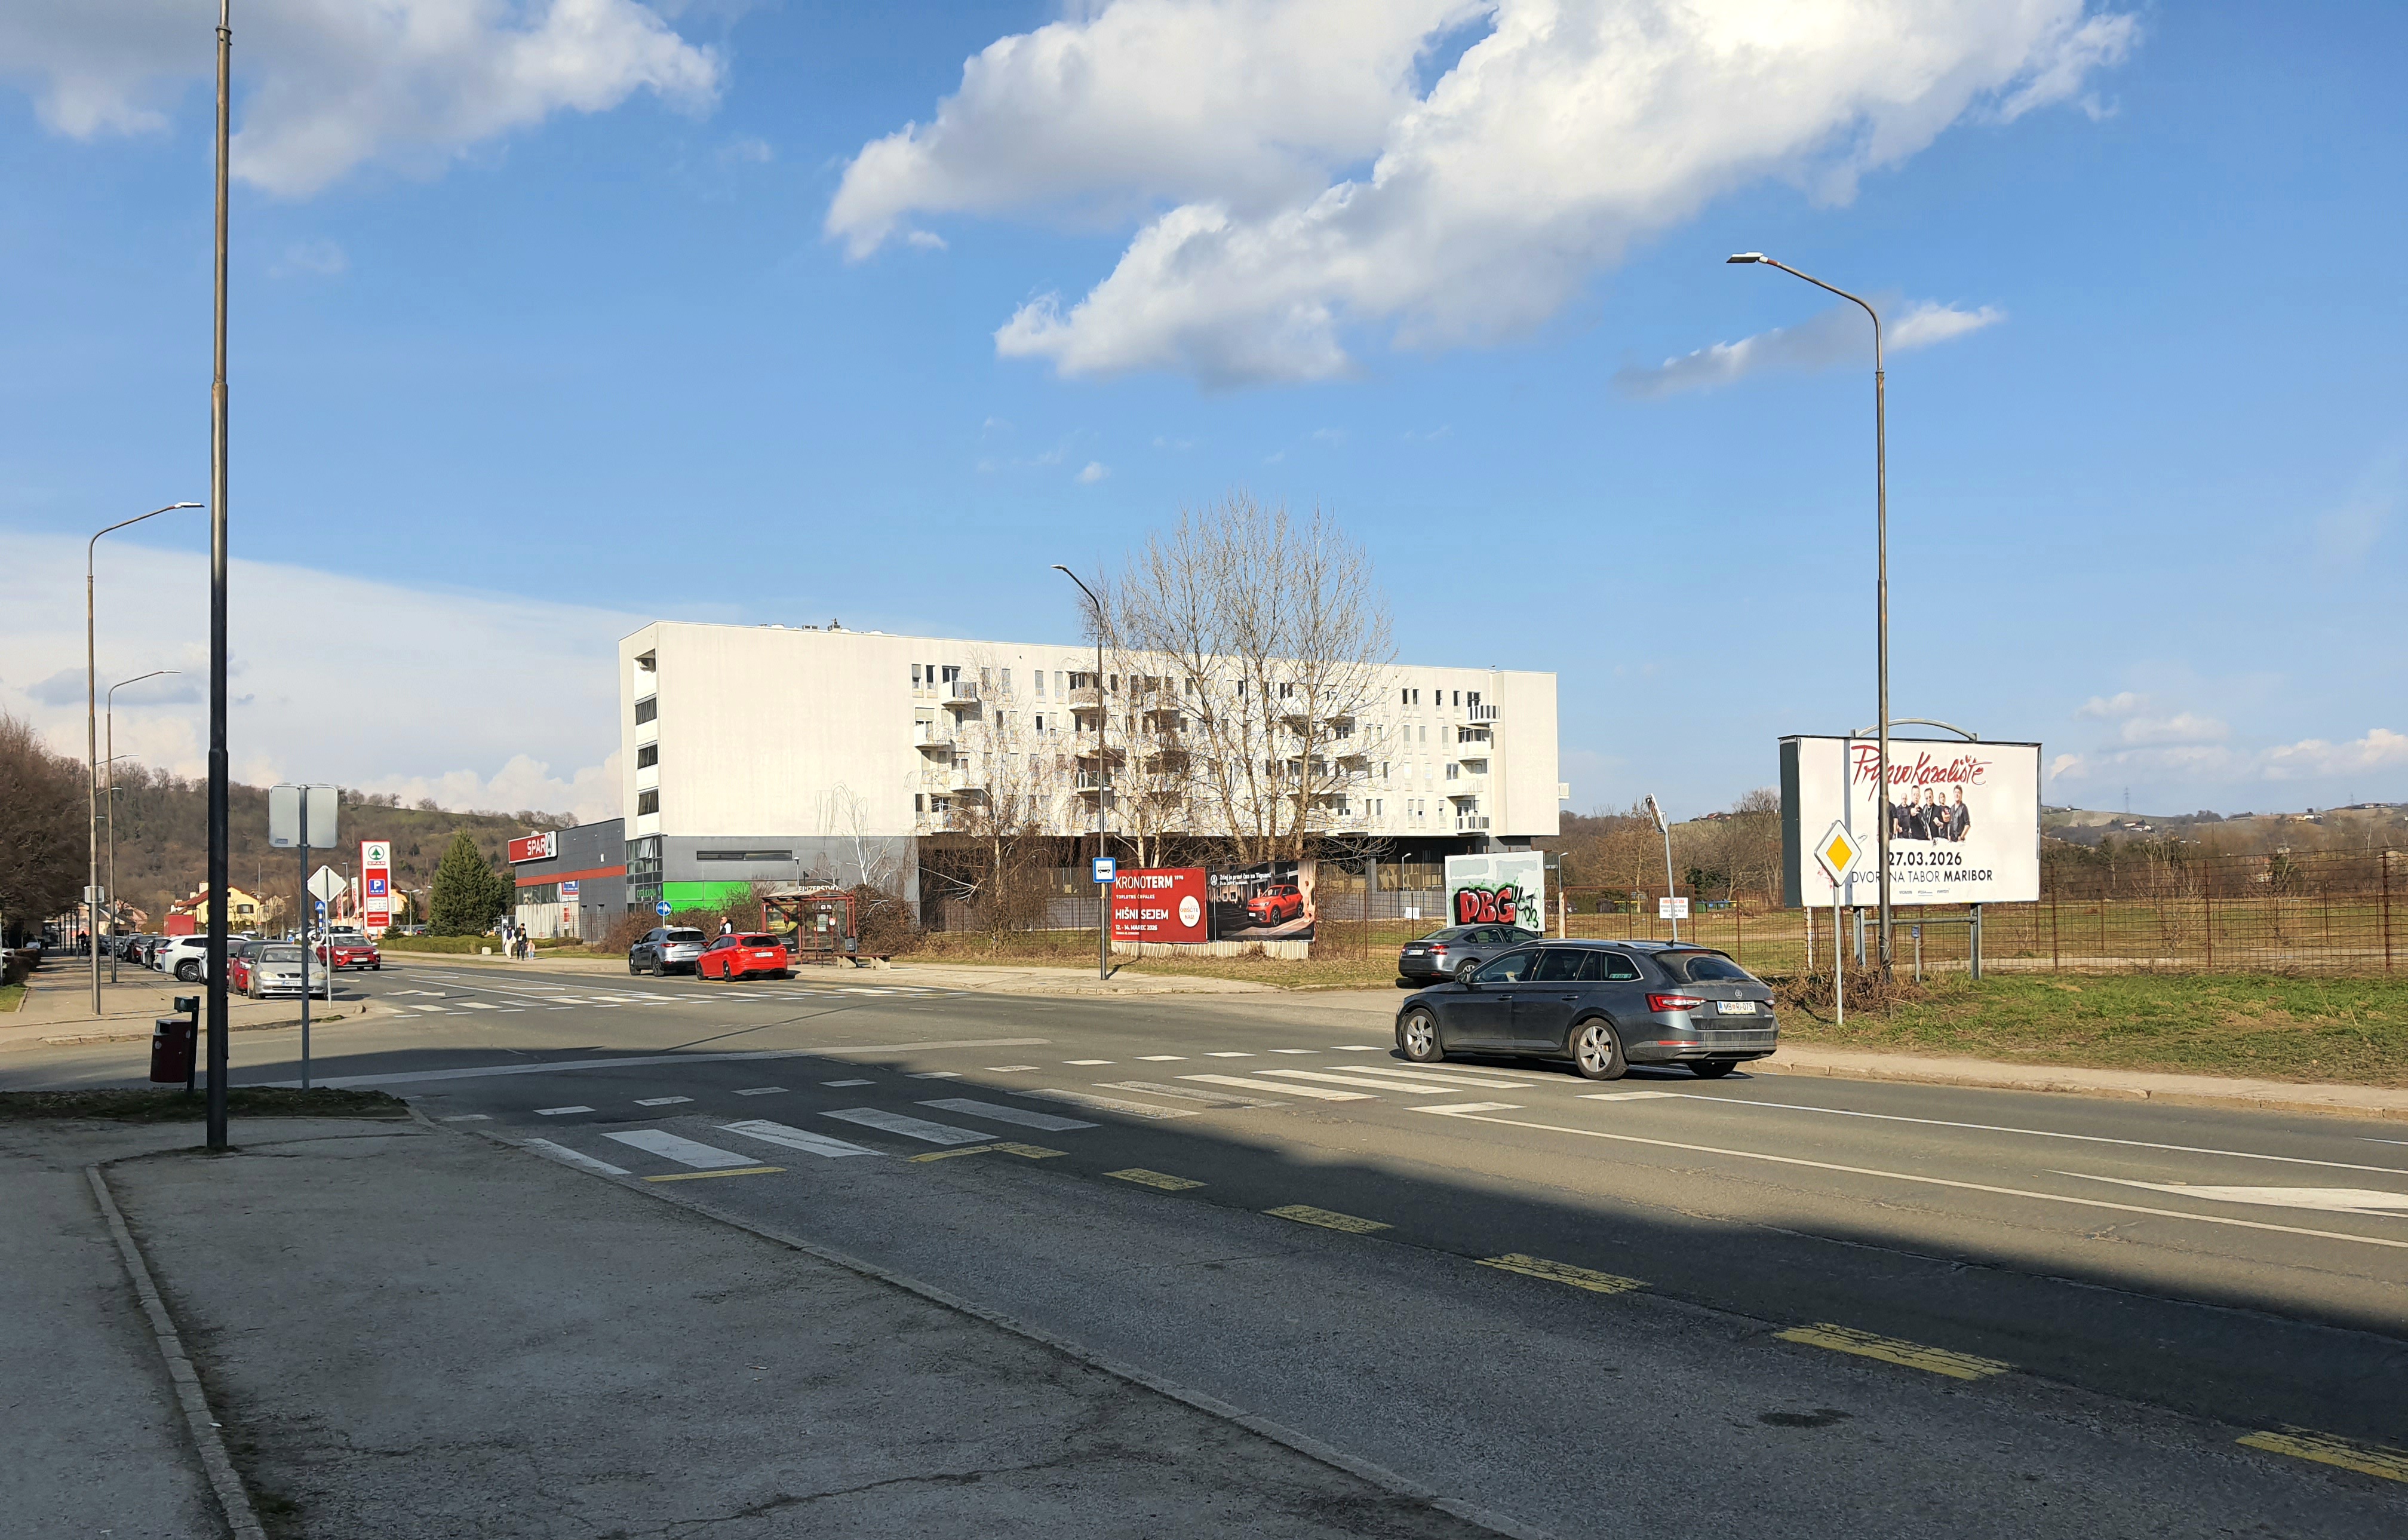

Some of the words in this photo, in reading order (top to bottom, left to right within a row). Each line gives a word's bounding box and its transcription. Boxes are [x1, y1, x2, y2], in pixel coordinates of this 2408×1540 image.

[527, 838, 546, 856] SPAR
[1889, 852, 1962, 866] 27.03.2026
[1116, 875, 1173, 889] KRONOTERM
[1852, 871, 1905, 883] DVORNA
[1908, 870, 1940, 882] TABOR
[1944, 870, 1993, 882] MARIBOR
[373, 880, 382, 889] P
[1115, 906, 1138, 919] HIŠNI
[1141, 909, 1169, 919] SEJEM
[1736, 1002, 1753, 1011] RI-075
